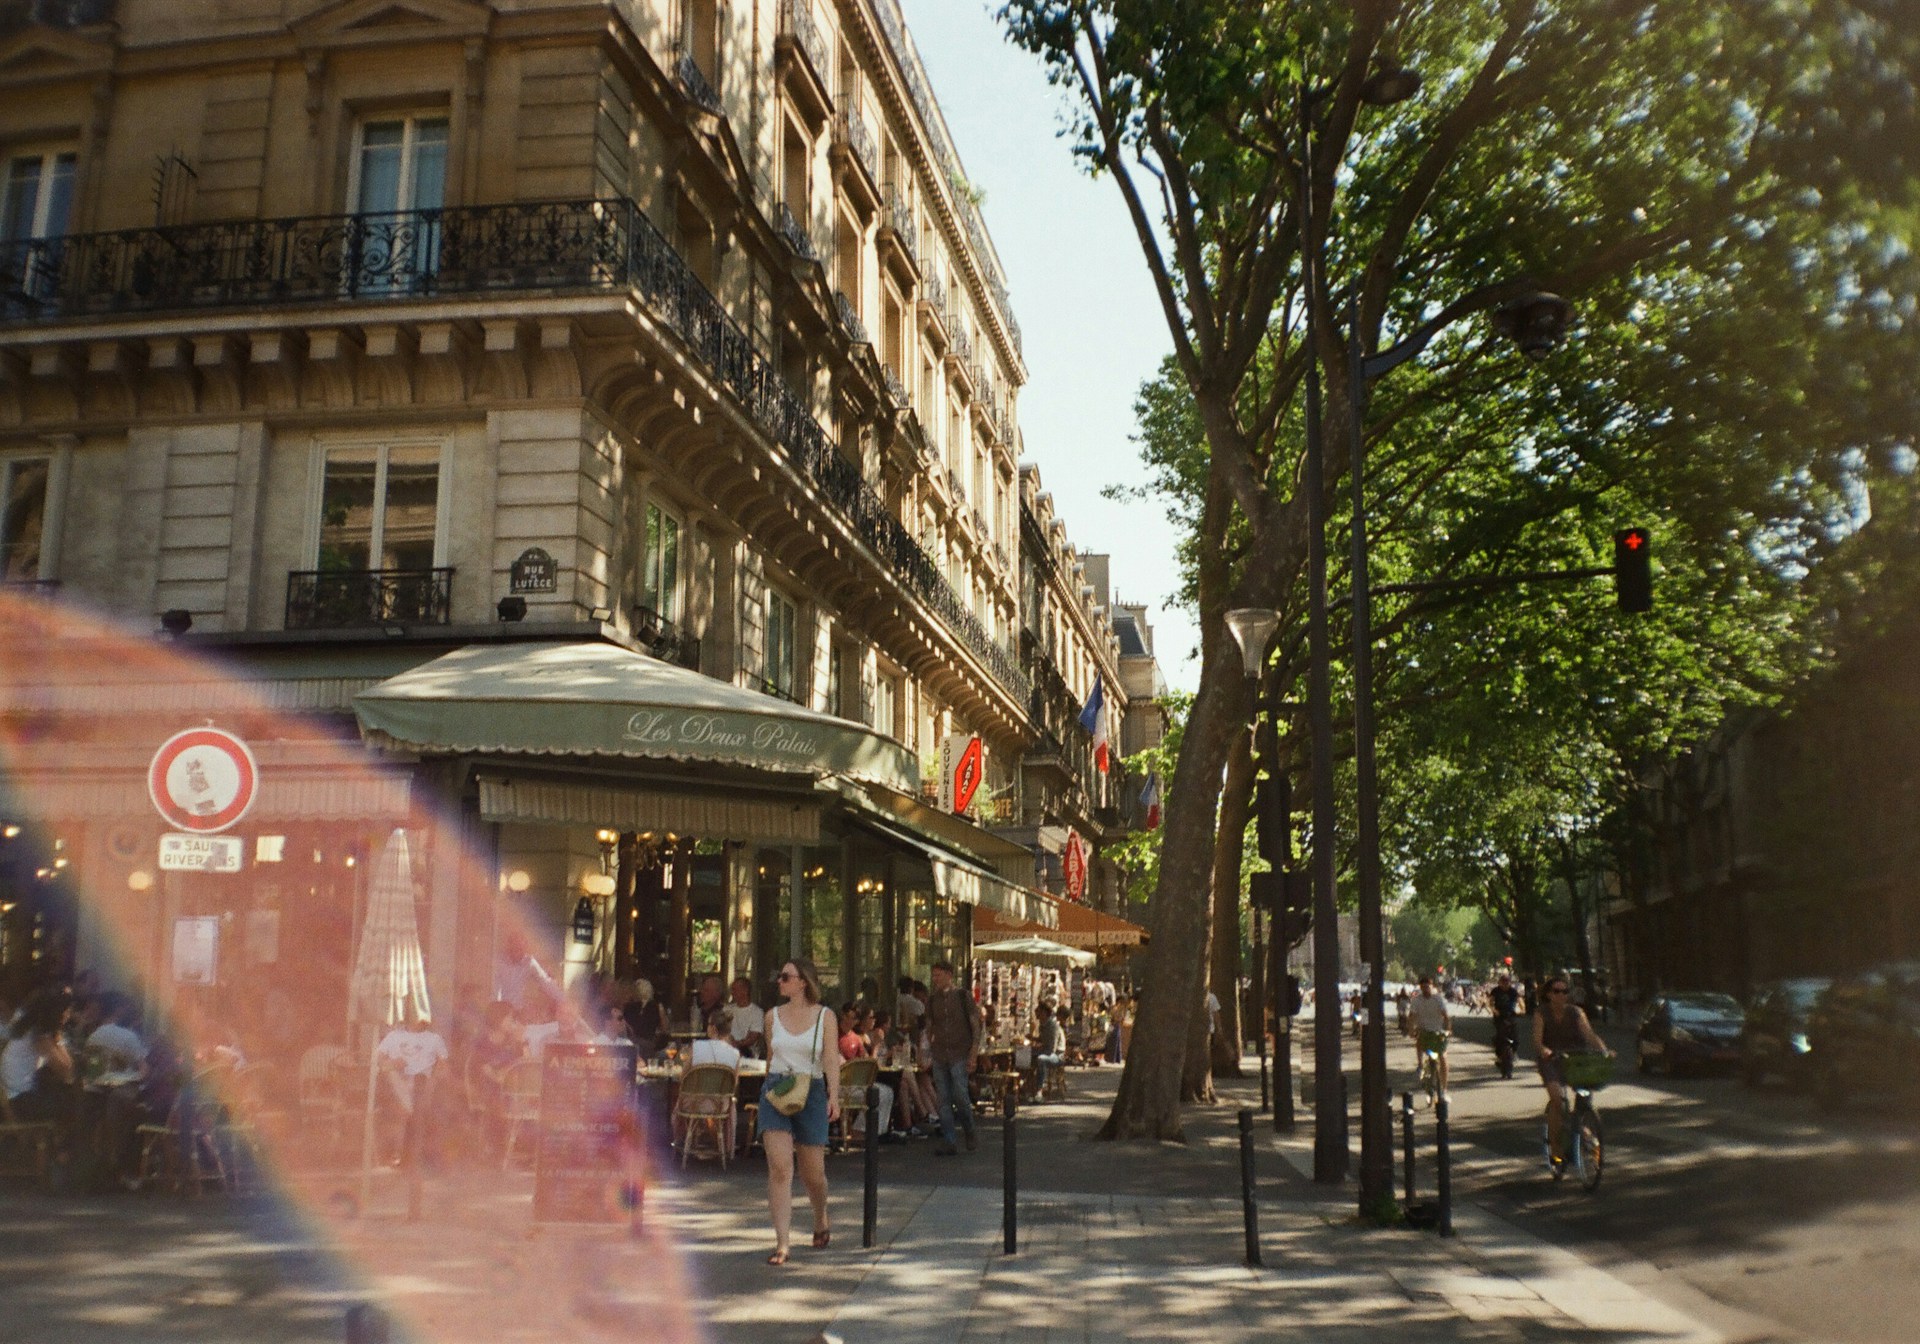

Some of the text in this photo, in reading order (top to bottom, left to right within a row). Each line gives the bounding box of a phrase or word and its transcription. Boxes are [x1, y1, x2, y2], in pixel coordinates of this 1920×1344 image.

[523, 565, 545, 575] RUE
[622, 710, 817, 756] Les Deux Palais
[961, 756, 975, 795] TABAC
[184, 840, 217, 852] SAU
[163, 854, 236, 867] RIVERS
[1068, 838, 1079, 895] TABAC
